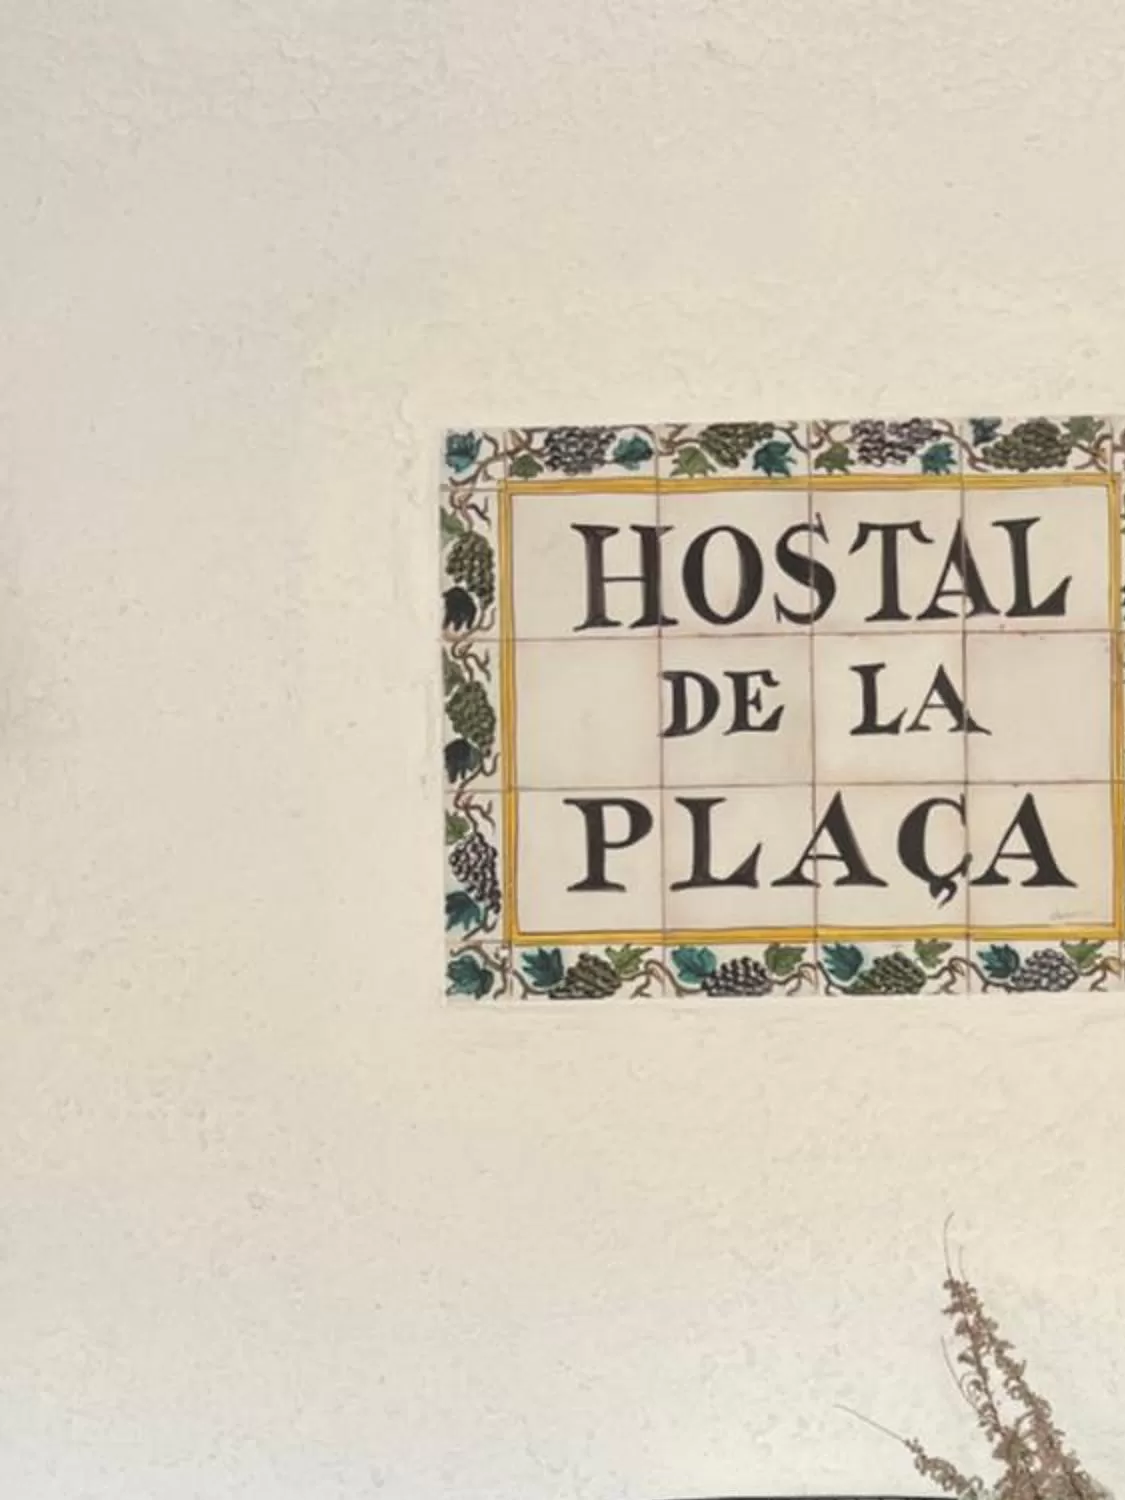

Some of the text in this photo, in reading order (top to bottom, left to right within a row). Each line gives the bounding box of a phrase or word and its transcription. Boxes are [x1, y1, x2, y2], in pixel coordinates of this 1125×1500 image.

[570, 513, 1073, 632] HOSTAL
[660, 663, 992, 739] DE LA
[563, 791, 1077, 908] PLAÇA
